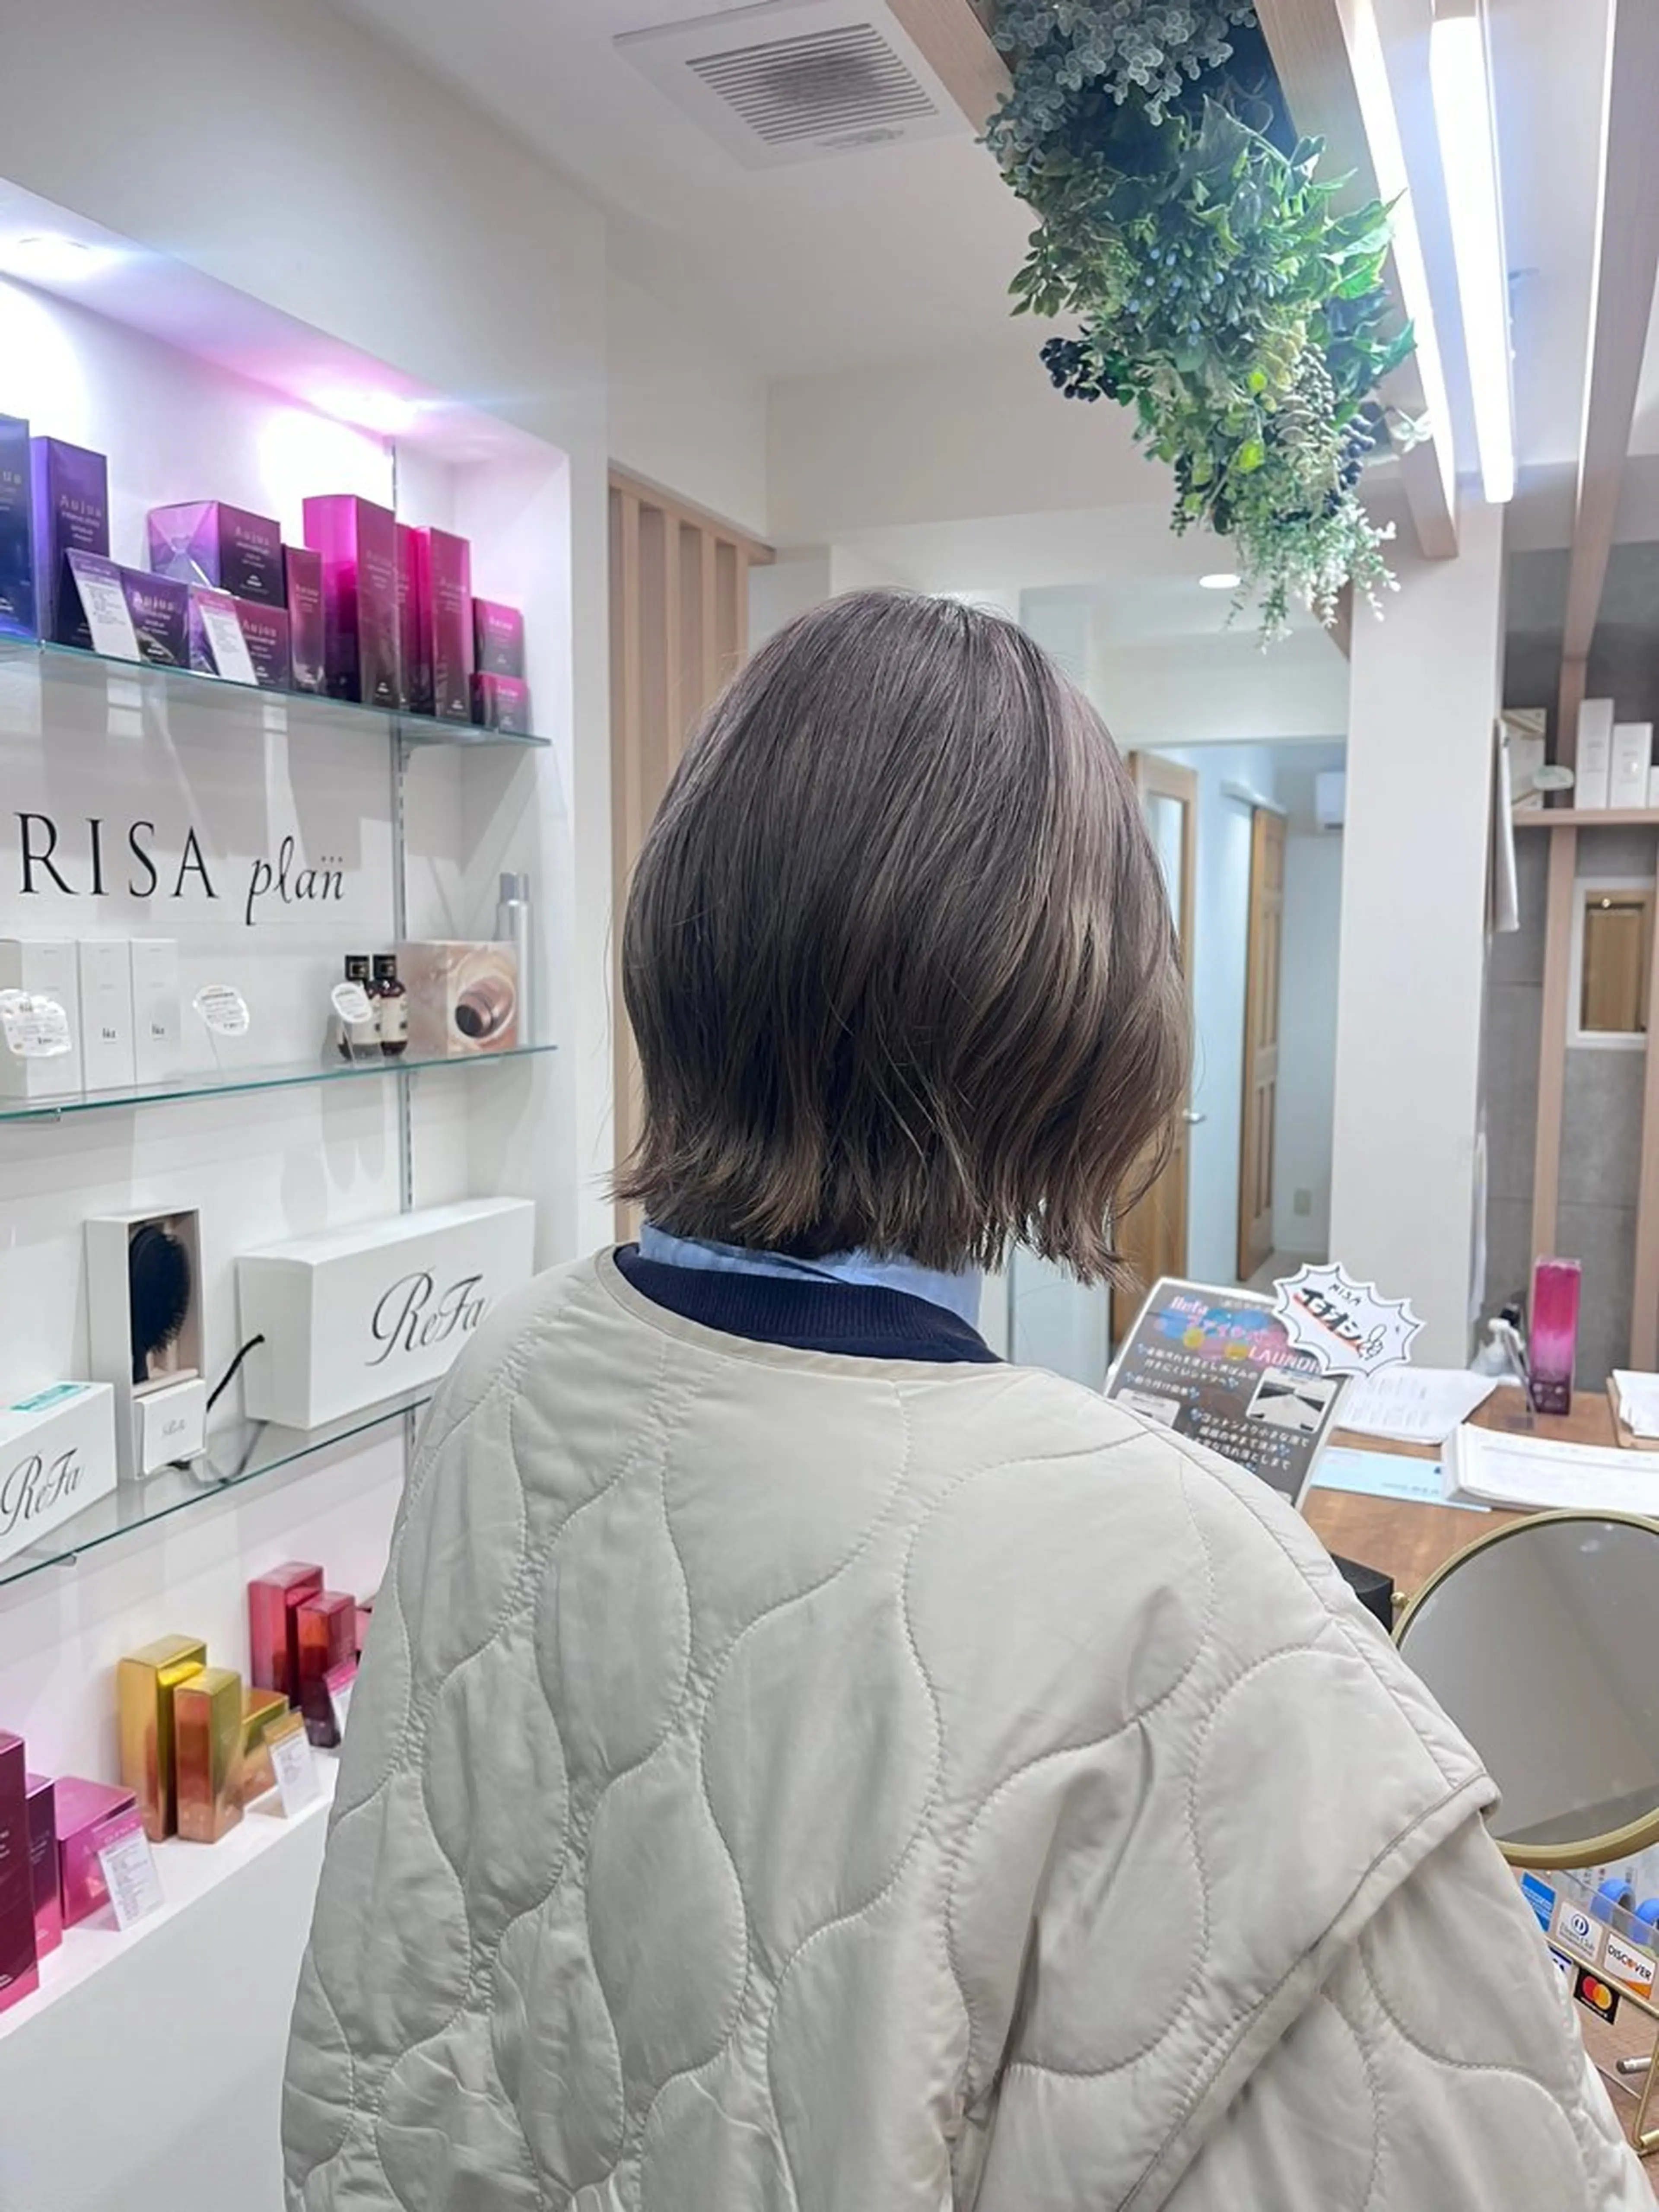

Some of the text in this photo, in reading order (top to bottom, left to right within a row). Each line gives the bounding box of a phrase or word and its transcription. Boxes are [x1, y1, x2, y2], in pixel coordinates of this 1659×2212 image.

[15, 812, 219, 899] RISA
[365, 1271, 485, 1367] ReFa
[0, 1447, 82, 1537] ReFa
